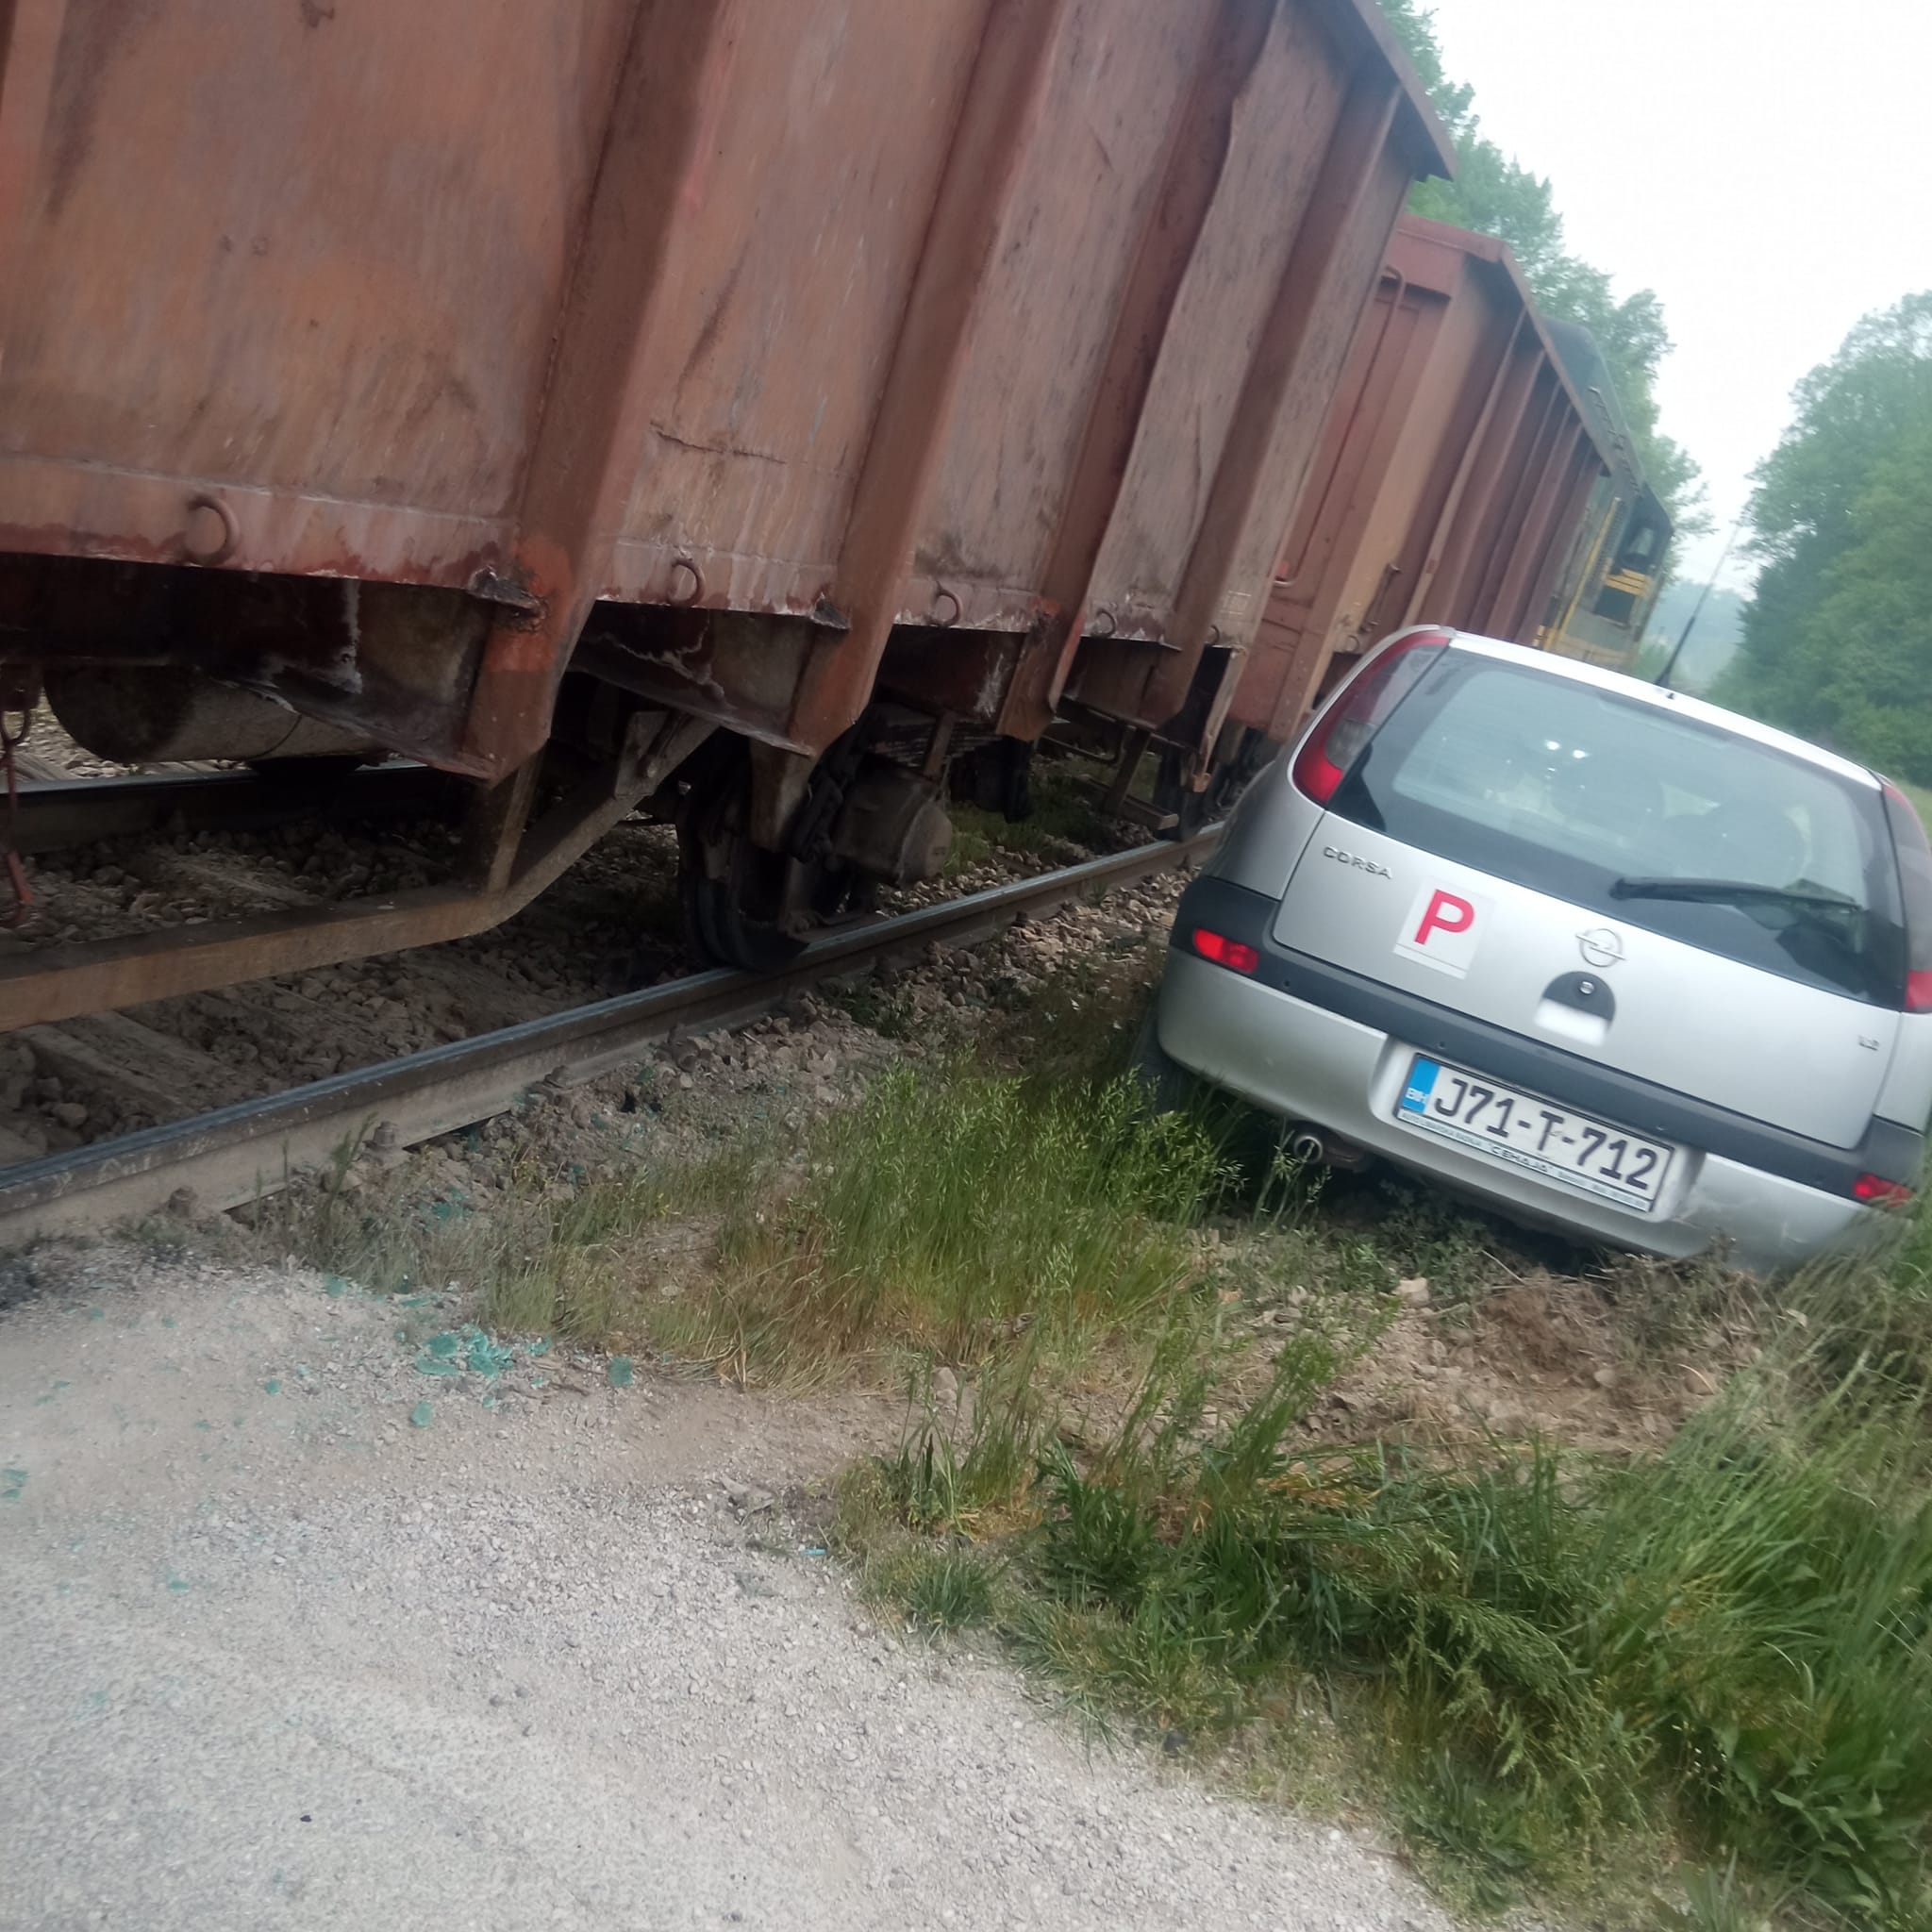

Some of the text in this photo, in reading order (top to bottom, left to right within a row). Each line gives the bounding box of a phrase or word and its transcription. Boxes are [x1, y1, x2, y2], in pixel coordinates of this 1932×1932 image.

[1323, 845, 1393, 880] CORSA
[1414, 889, 1474, 946] P
[1435, 1078, 1657, 1190] J71-T-712
